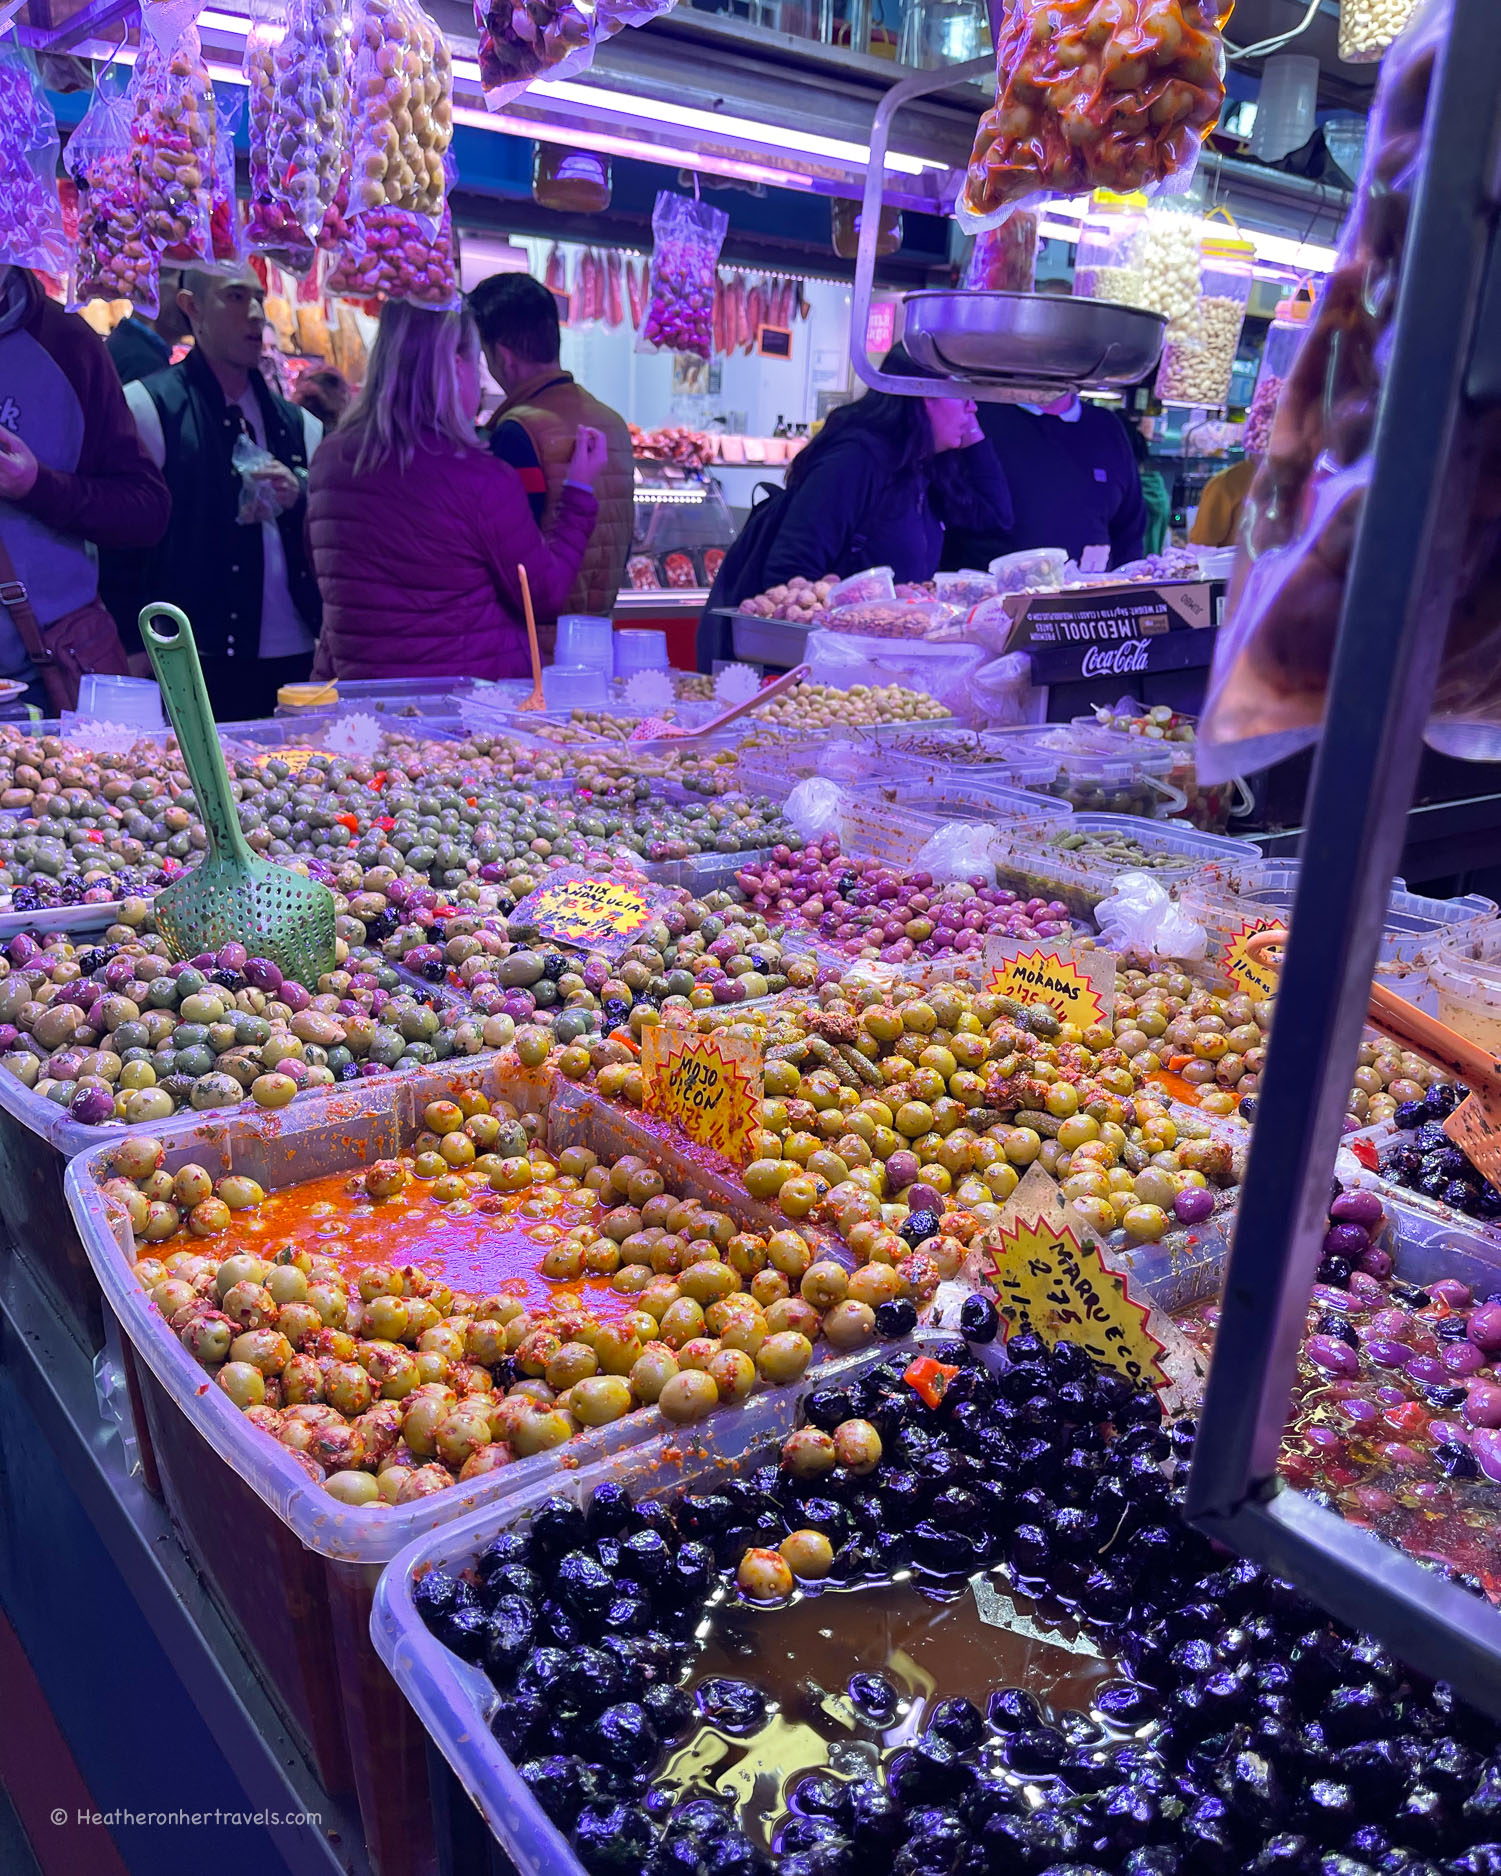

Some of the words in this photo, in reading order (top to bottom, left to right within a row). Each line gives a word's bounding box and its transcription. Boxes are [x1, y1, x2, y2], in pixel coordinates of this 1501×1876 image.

[1061, 619, 1132, 640] MEDJOOL
[579, 884, 611, 895] MIX
[1012, 967, 1081, 1000] MORADAS
[681, 1057, 718, 1087] MOJO
